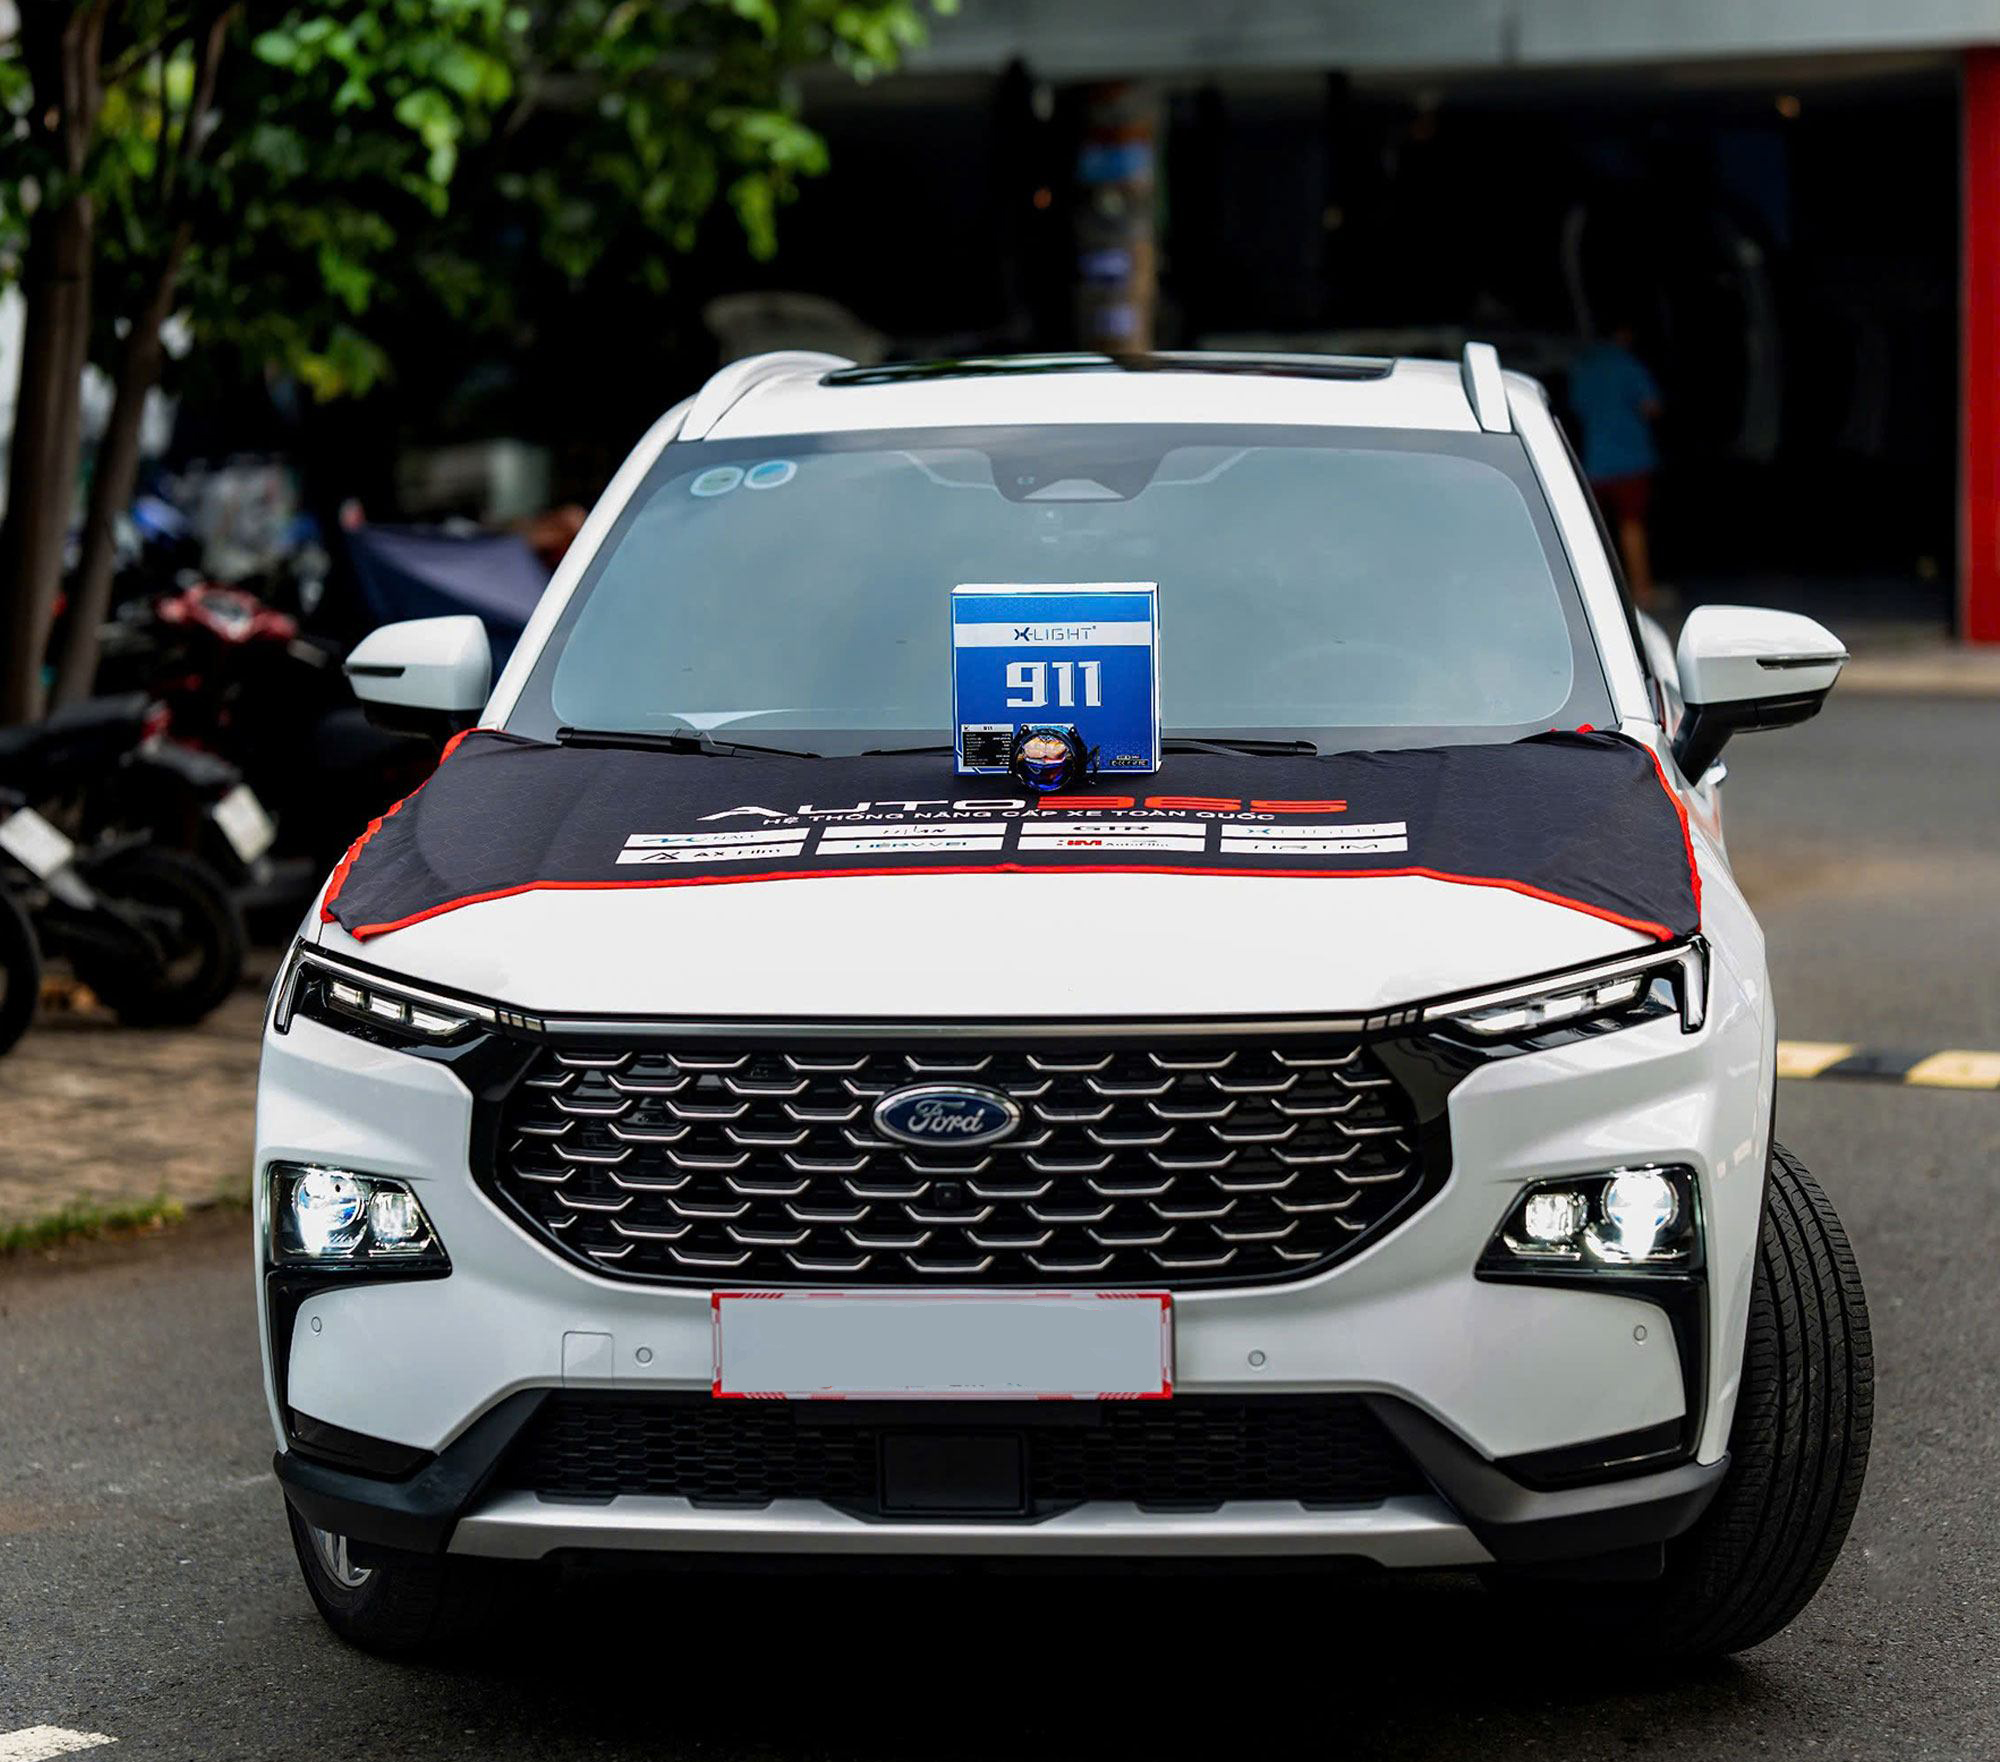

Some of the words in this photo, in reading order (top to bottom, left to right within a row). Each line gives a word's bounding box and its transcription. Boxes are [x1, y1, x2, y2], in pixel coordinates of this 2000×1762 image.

[1014, 626, 1092, 642] X-LIGHT
[1006, 660, 1102, 708] 911
[808, 812, 905, 822] THỐNG
[1001, 809, 1058, 818] CẤP
[1111, 809, 1186, 817] TOÀN
[1195, 811, 1276, 821] QUỐC
[907, 1100, 986, 1133] Ford
